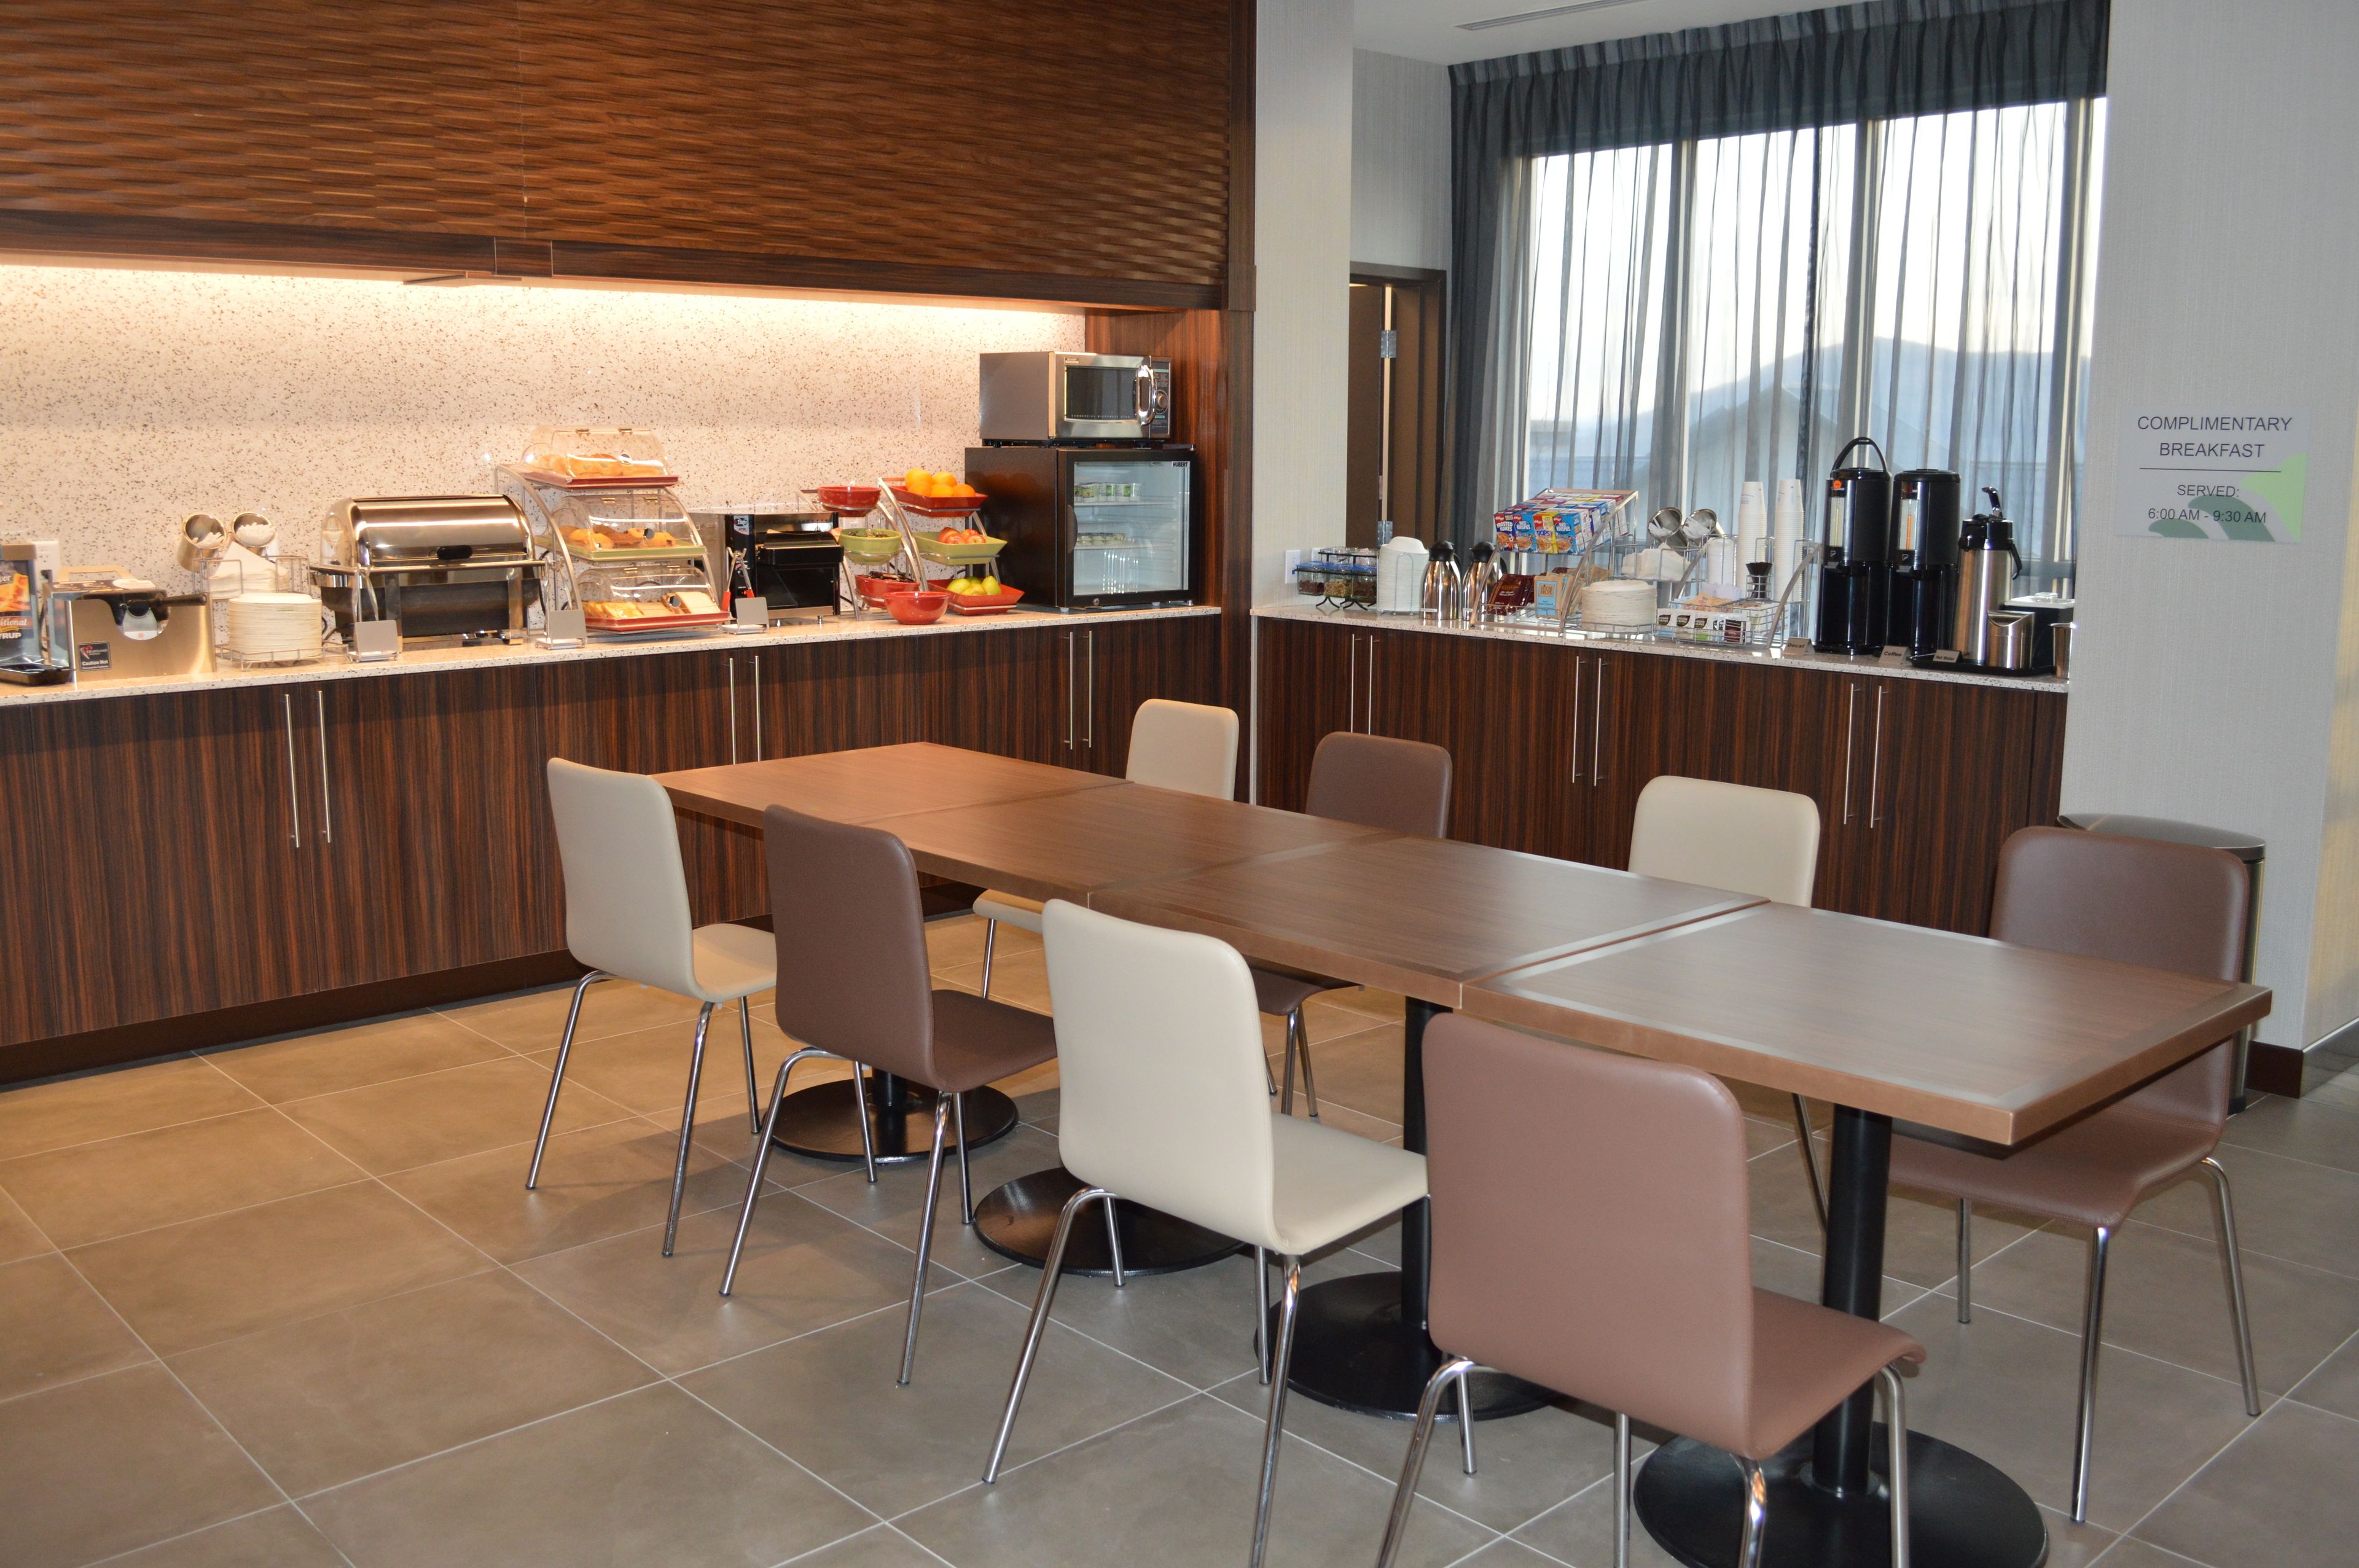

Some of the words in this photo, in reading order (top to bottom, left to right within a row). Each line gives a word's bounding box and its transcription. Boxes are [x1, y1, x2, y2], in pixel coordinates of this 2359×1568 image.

[2137, 416, 2293, 431] COMPLIMENTARY
[2159, 442, 2265, 458] BREAKFAST
[2177, 484, 2240, 497] SERVED:
[2148, 508, 2175, 520] 6:00
[2178, 509, 2200, 521] AM
[2212, 510, 2241, 523] 9:30
[2244, 512, 2266, 523] AM
